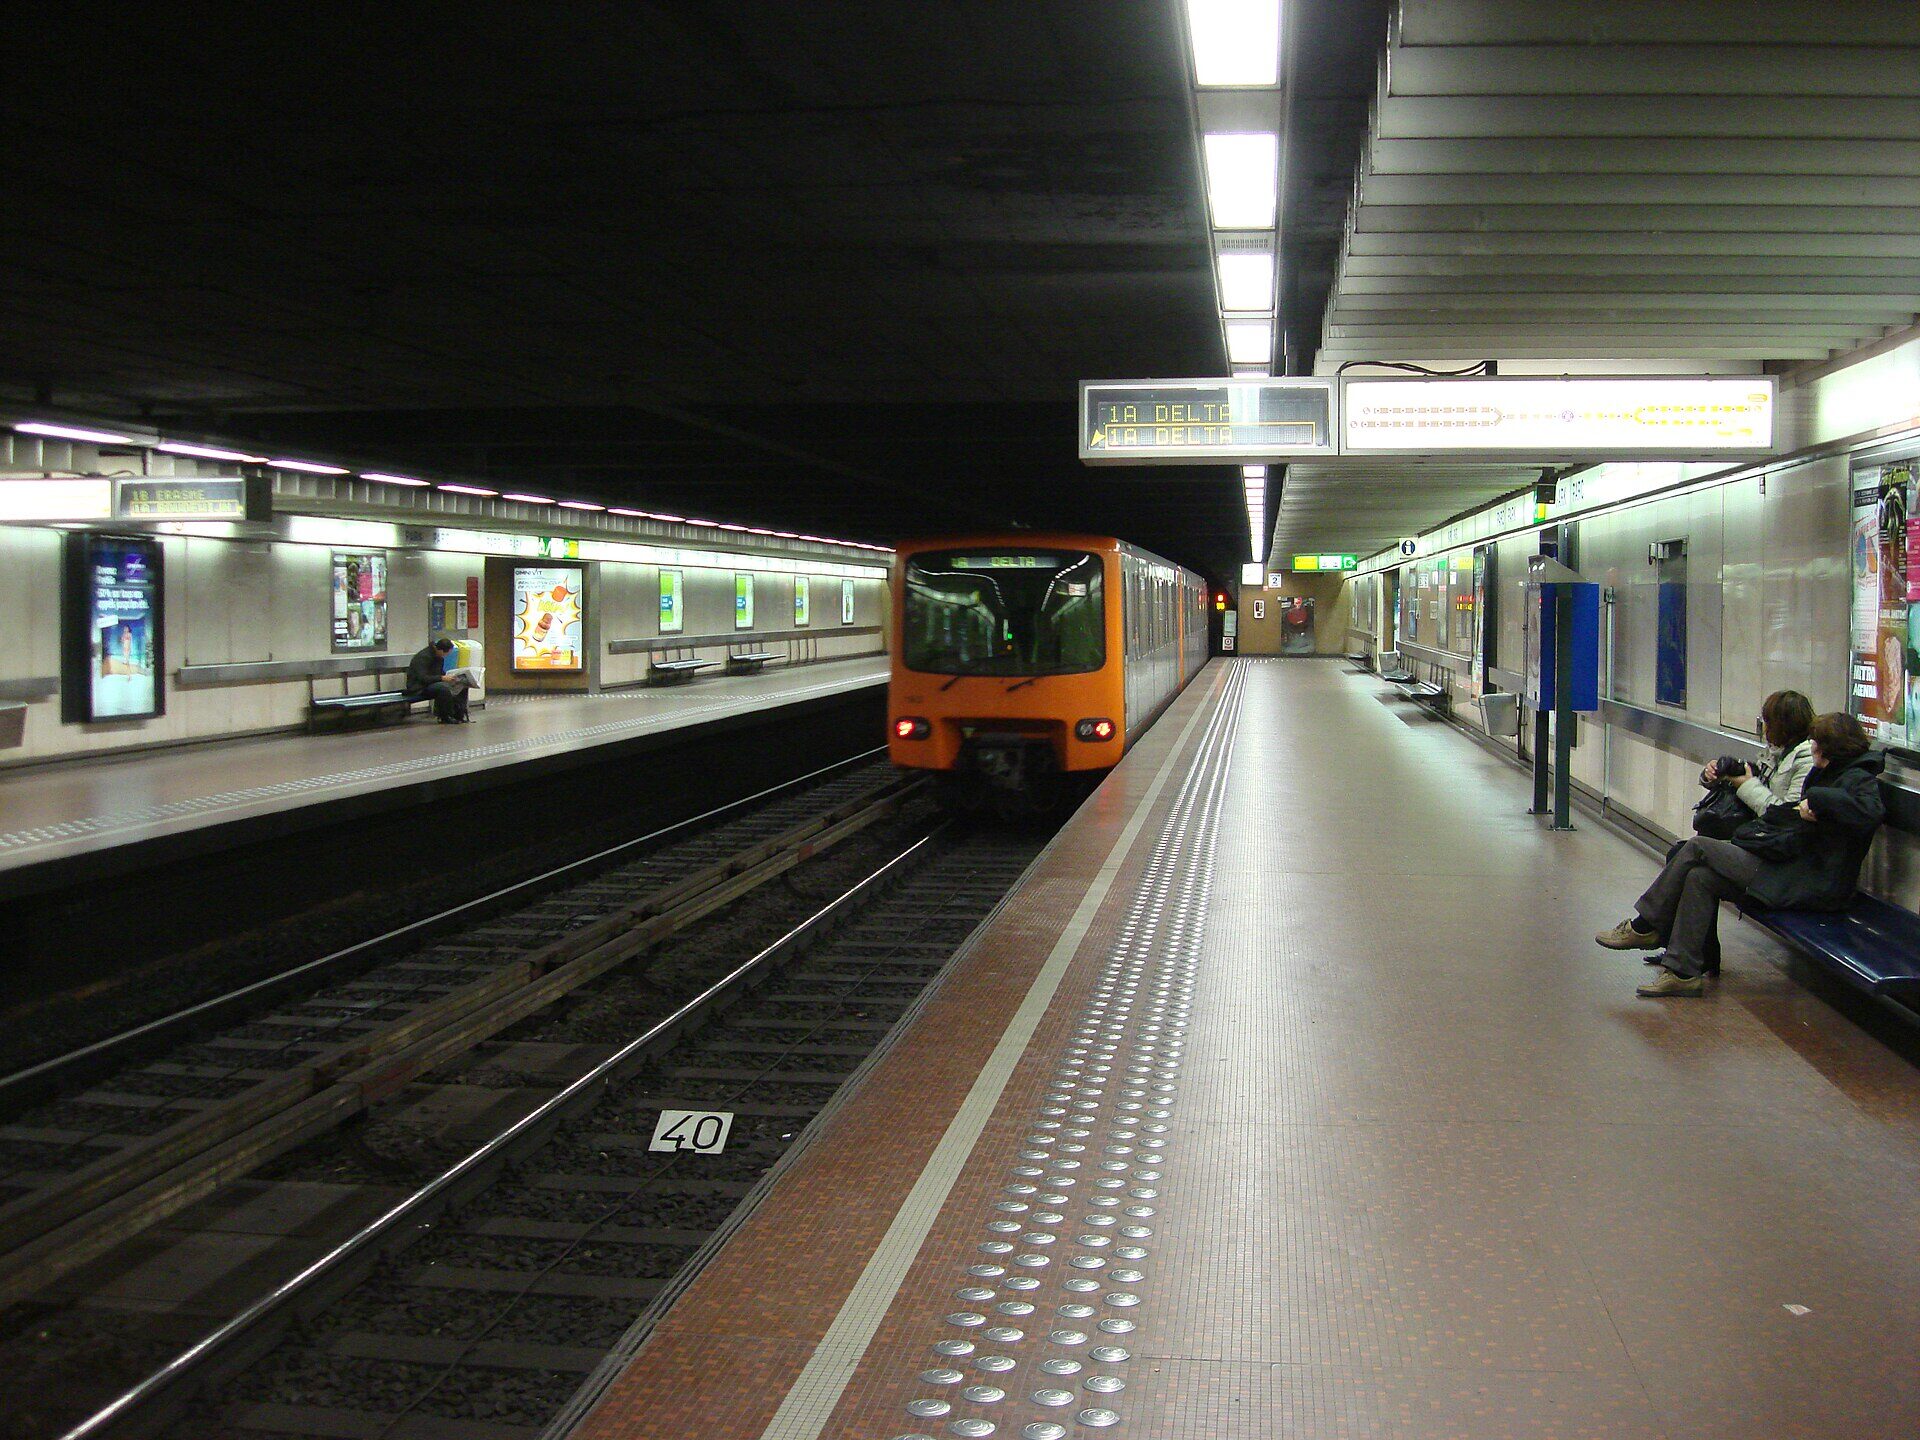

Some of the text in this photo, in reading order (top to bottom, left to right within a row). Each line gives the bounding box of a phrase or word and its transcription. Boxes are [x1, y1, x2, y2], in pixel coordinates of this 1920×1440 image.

[1110, 403, 1232, 423] 1A DELTA
[1110, 427, 1233, 445] 1A DELTA
[156, 488, 205, 500] ERASME
[991, 557, 1035, 567] DELTA
[1272, 576, 1278, 585] 2
[1852, 682, 1877, 699] AGENDA
[660, 1115, 723, 1149] 40
